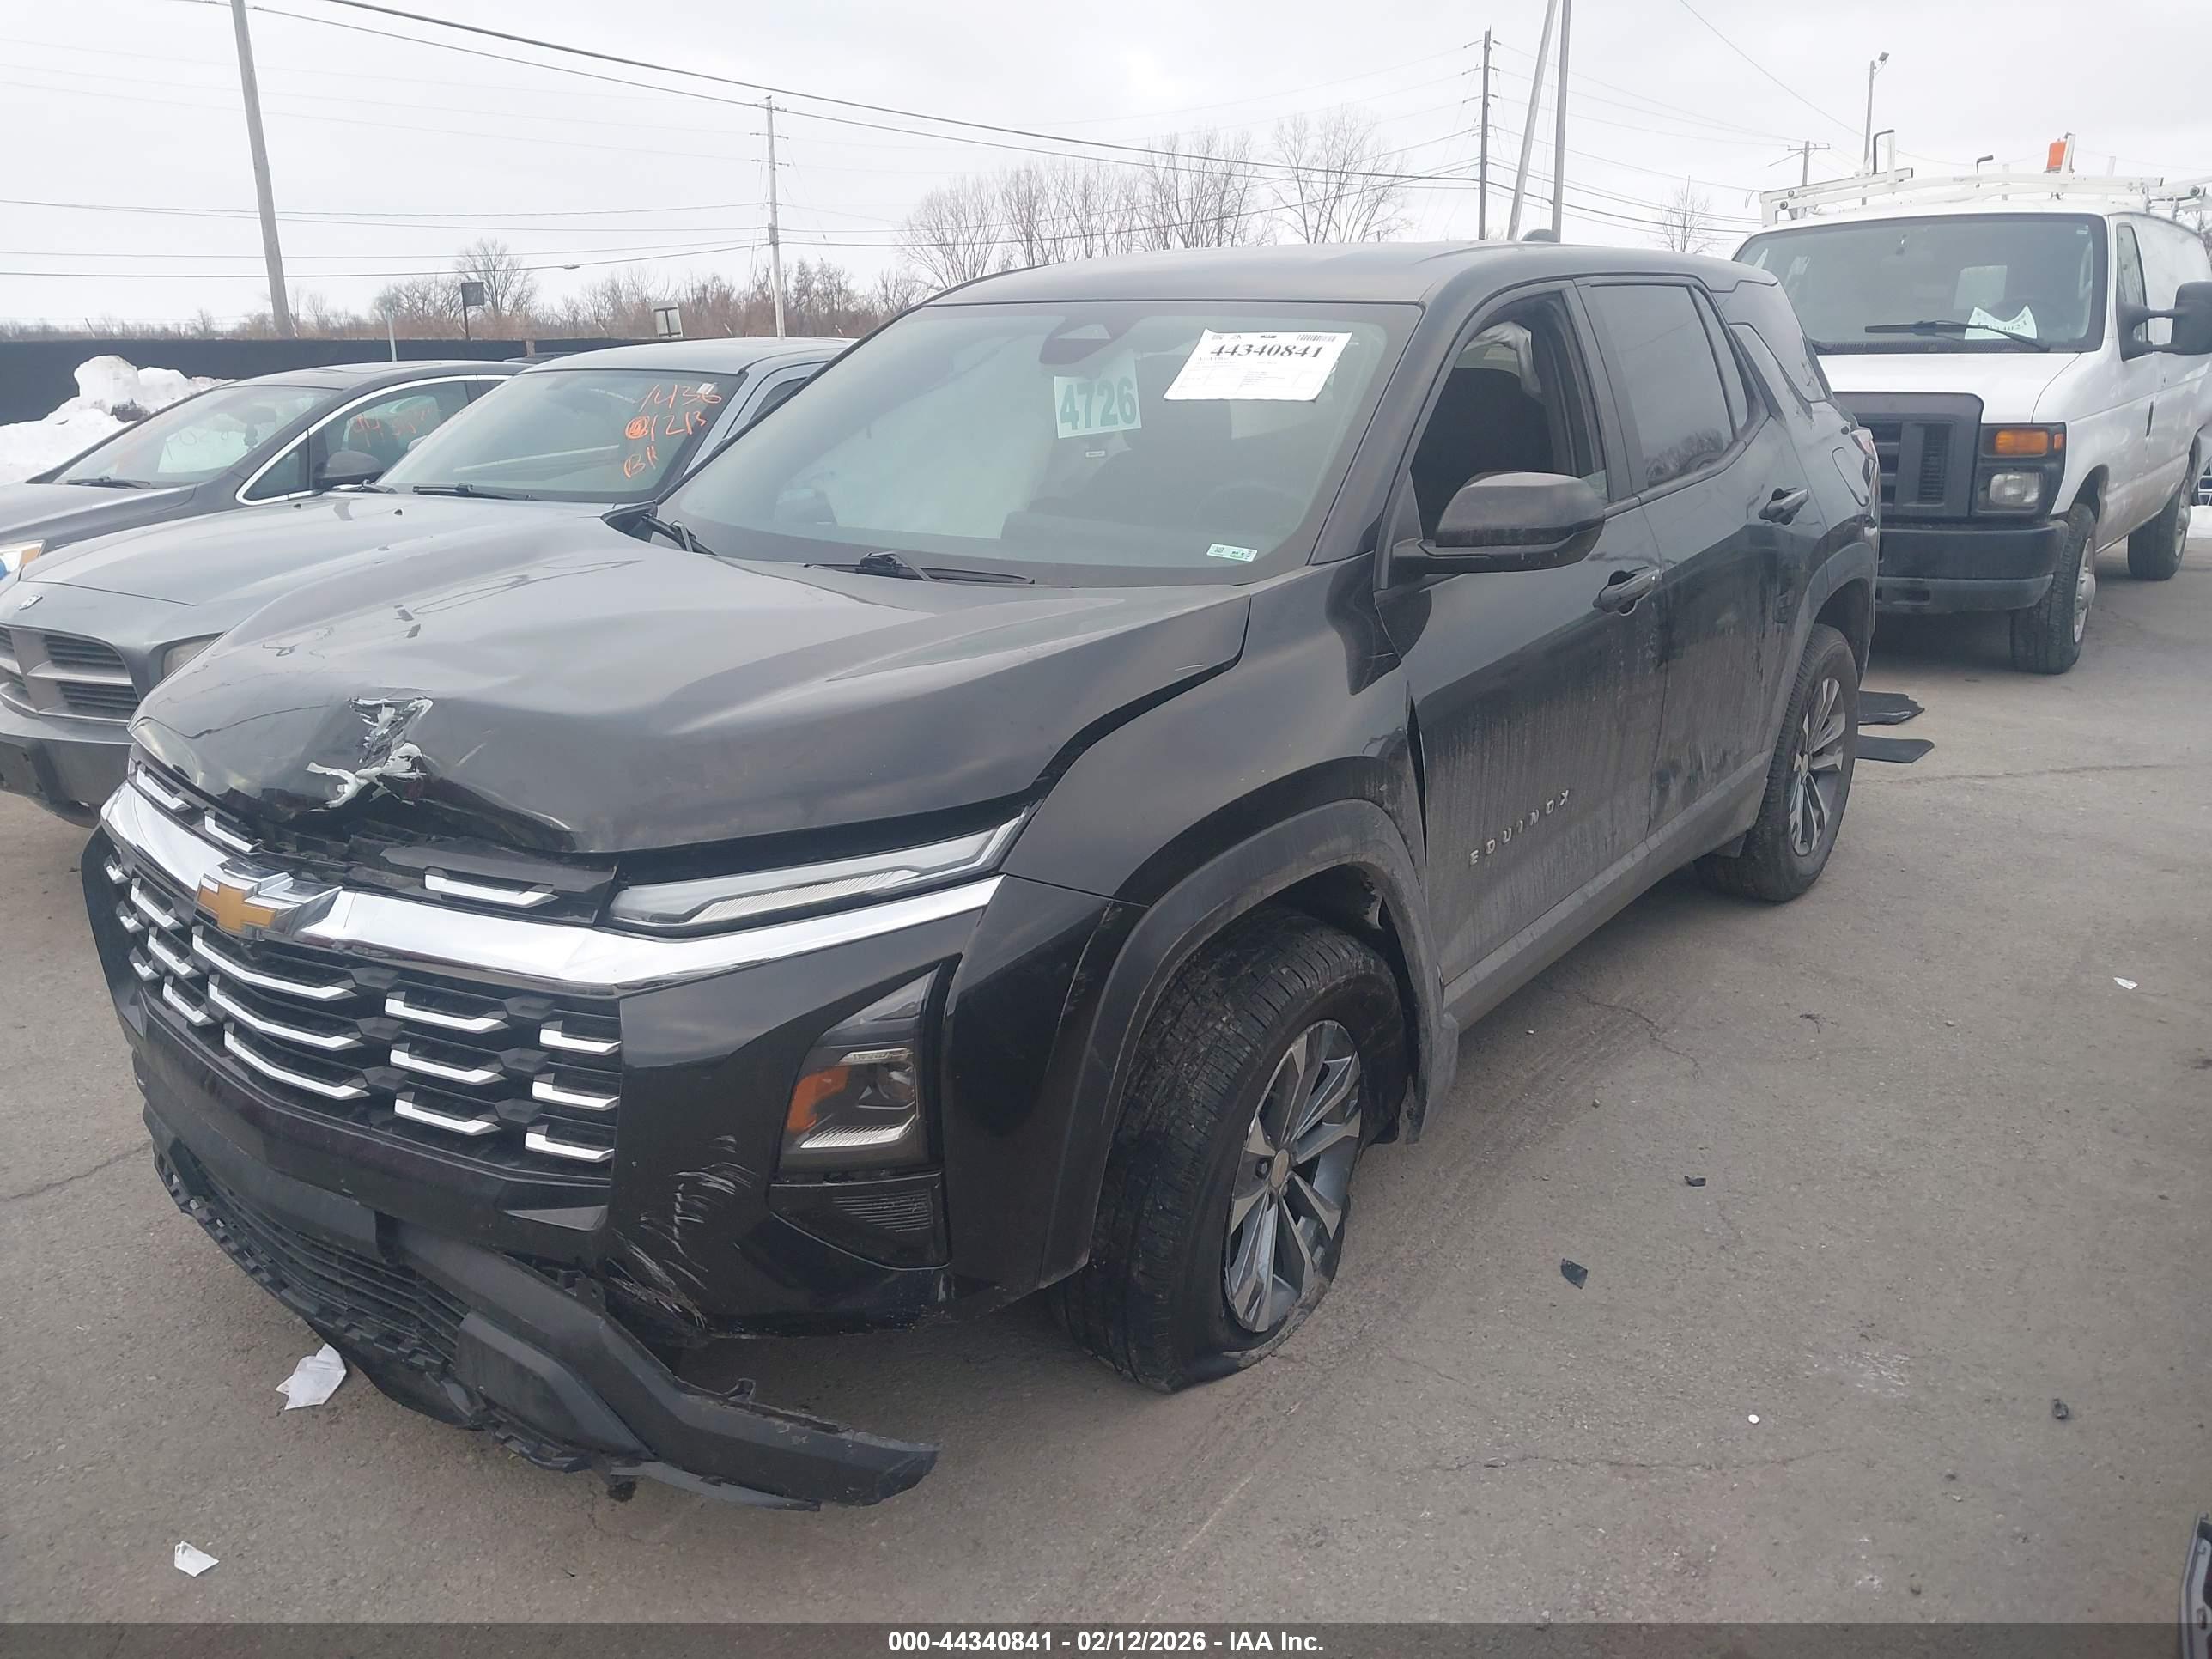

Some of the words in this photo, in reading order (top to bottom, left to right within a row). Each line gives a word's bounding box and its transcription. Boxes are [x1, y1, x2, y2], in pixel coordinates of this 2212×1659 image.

[1209, 343, 1323, 358] 44340841
[1060, 377, 1138, 431] 4726
[1469, 789, 1570, 866] EQUINOX
